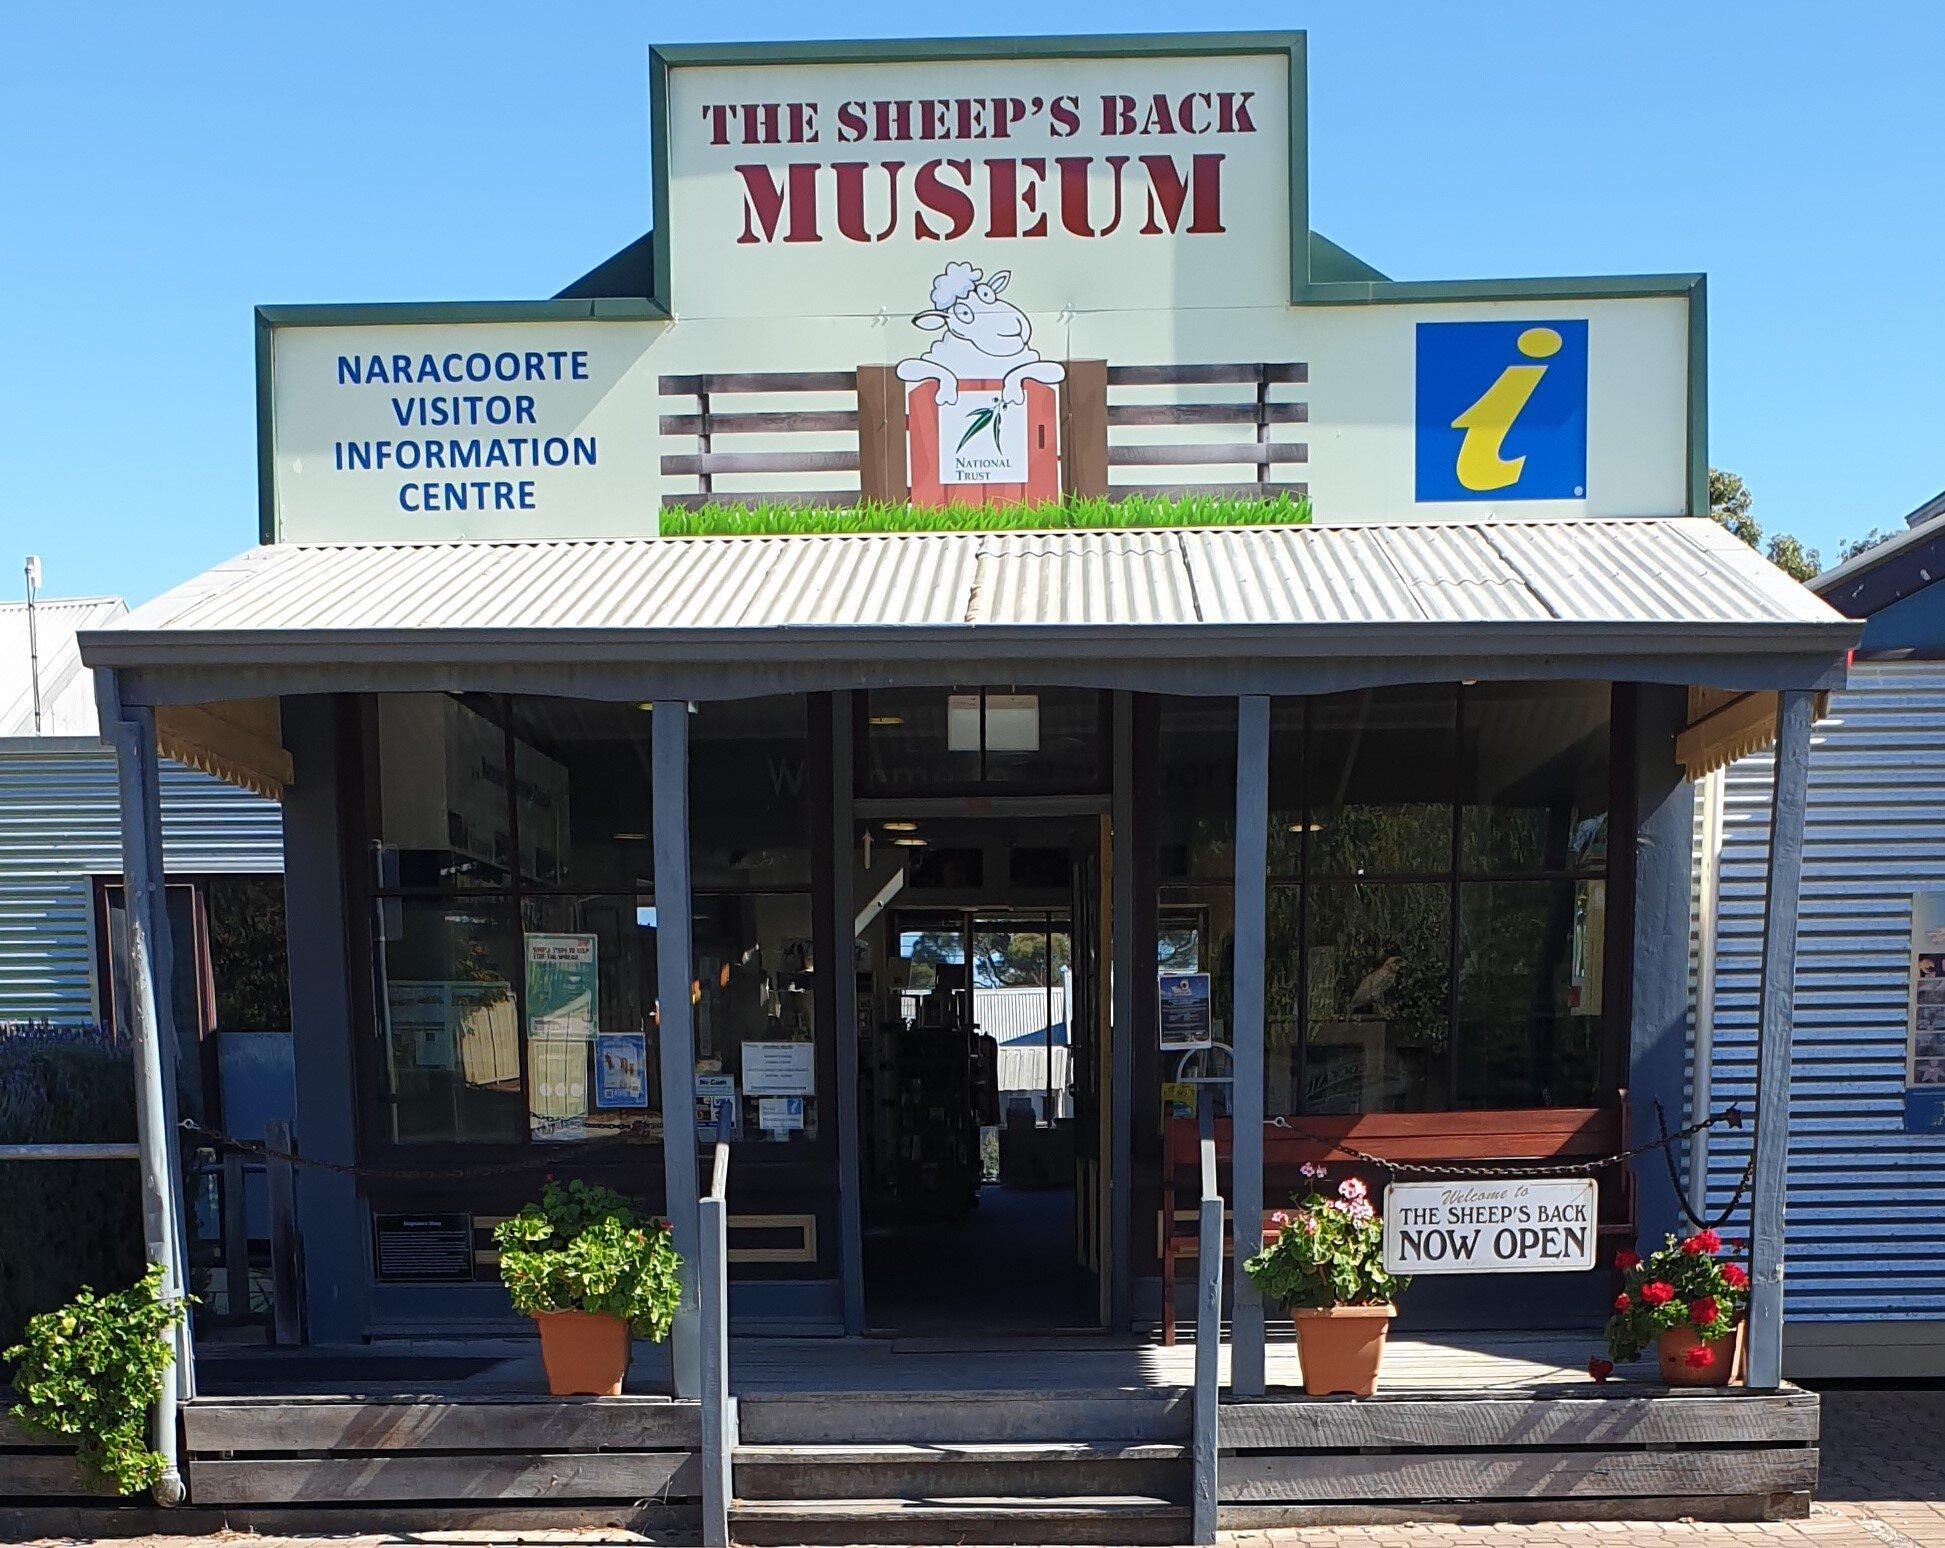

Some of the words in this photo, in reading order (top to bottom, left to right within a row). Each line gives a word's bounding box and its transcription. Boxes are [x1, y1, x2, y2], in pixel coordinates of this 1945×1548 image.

[702, 102, 820, 146] THE
[836, 95, 1081, 144] SHEEP'S
[1099, 91, 1258, 136] BACK
[734, 153, 1227, 245] MUSEUM
[337, 350, 589, 385] NARACOORTE
[391, 395, 538, 427] VISITOR
[335, 436, 598, 471] INFORMATION
[955, 457, 1012, 469] NATIONAL
[955, 469, 992, 481] TRUST
[399, 480, 537, 512] CENTRE
[1441, 1187, 1508, 1206] Welcome
[1513, 1185, 1529, 1199] to
[1399, 1207, 1441, 1226] THE
[1446, 1205, 1532, 1225] SHEEP'S
[1537, 1204, 1588, 1223] BACK
[1398, 1229, 1482, 1262] NOW
[1493, 1227, 1588, 1260] OPEN
